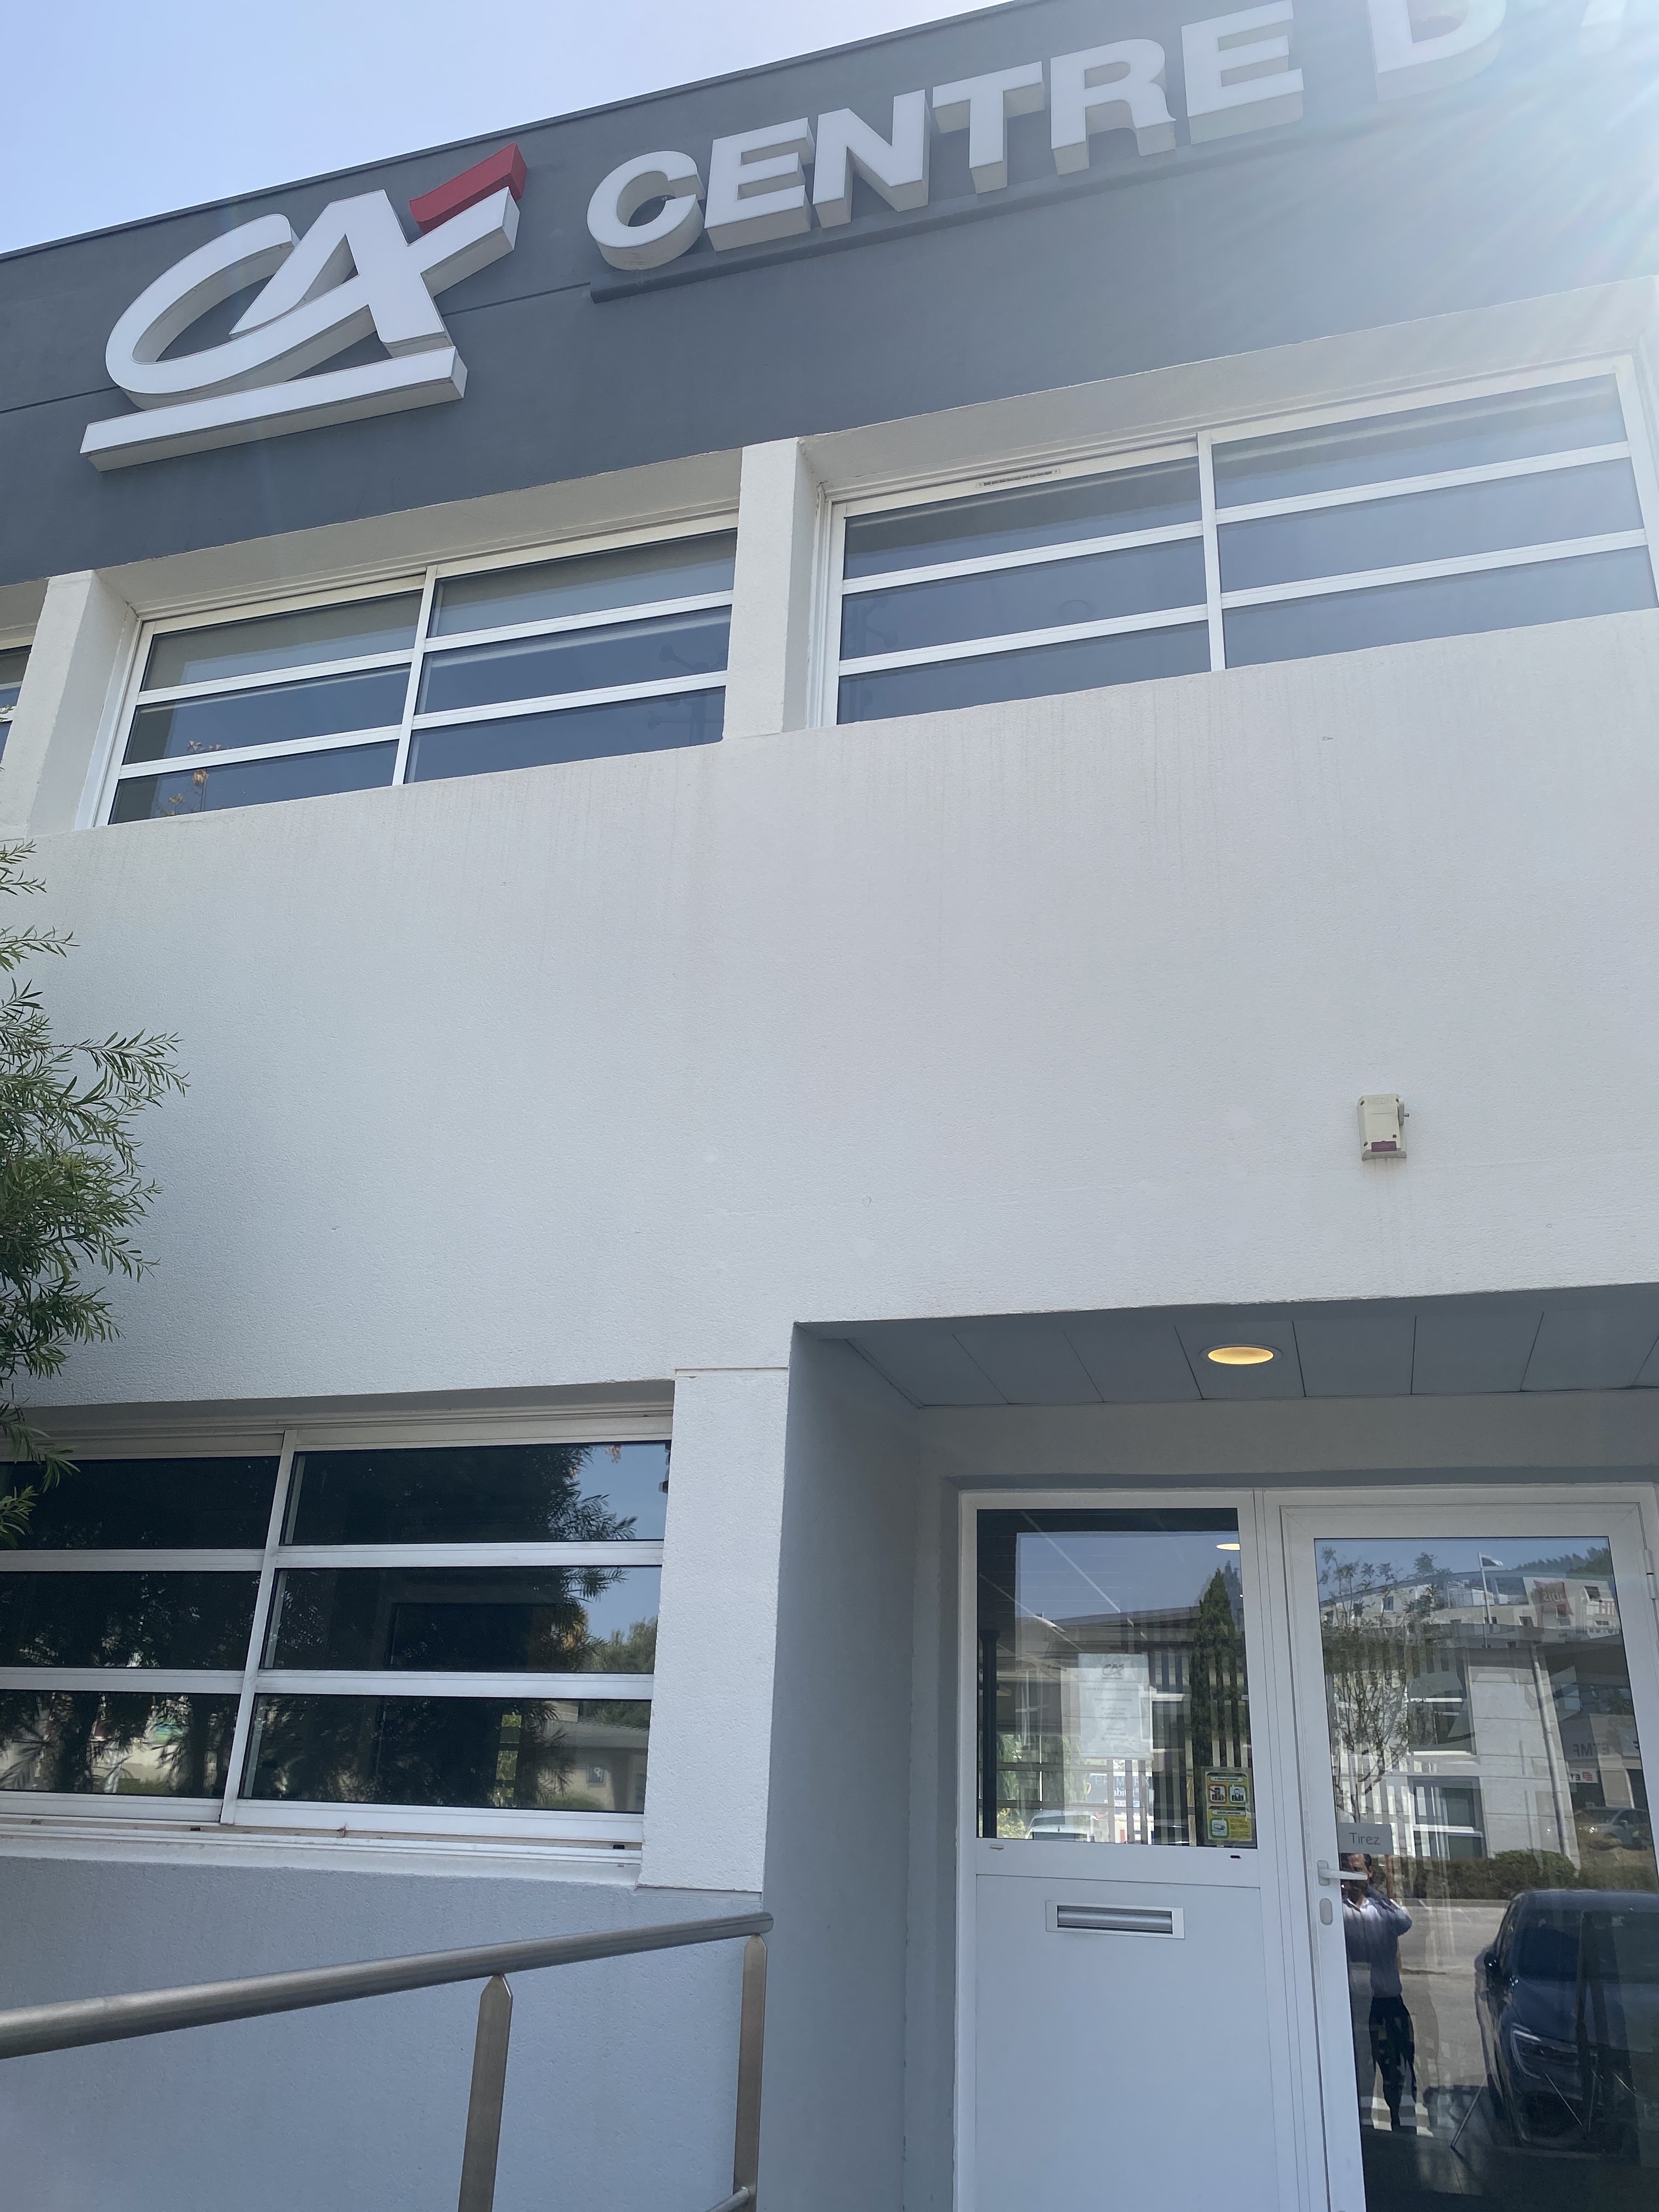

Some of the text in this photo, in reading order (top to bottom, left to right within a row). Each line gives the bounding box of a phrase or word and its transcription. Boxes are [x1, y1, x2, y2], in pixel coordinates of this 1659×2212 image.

[587, 0, 1305, 270] CENTRE
[1368, 1097, 1394, 1106] NEON
[1096, 1776, 1150, 1787] PRMRK
[1349, 1832, 1381, 1846] Tirez
